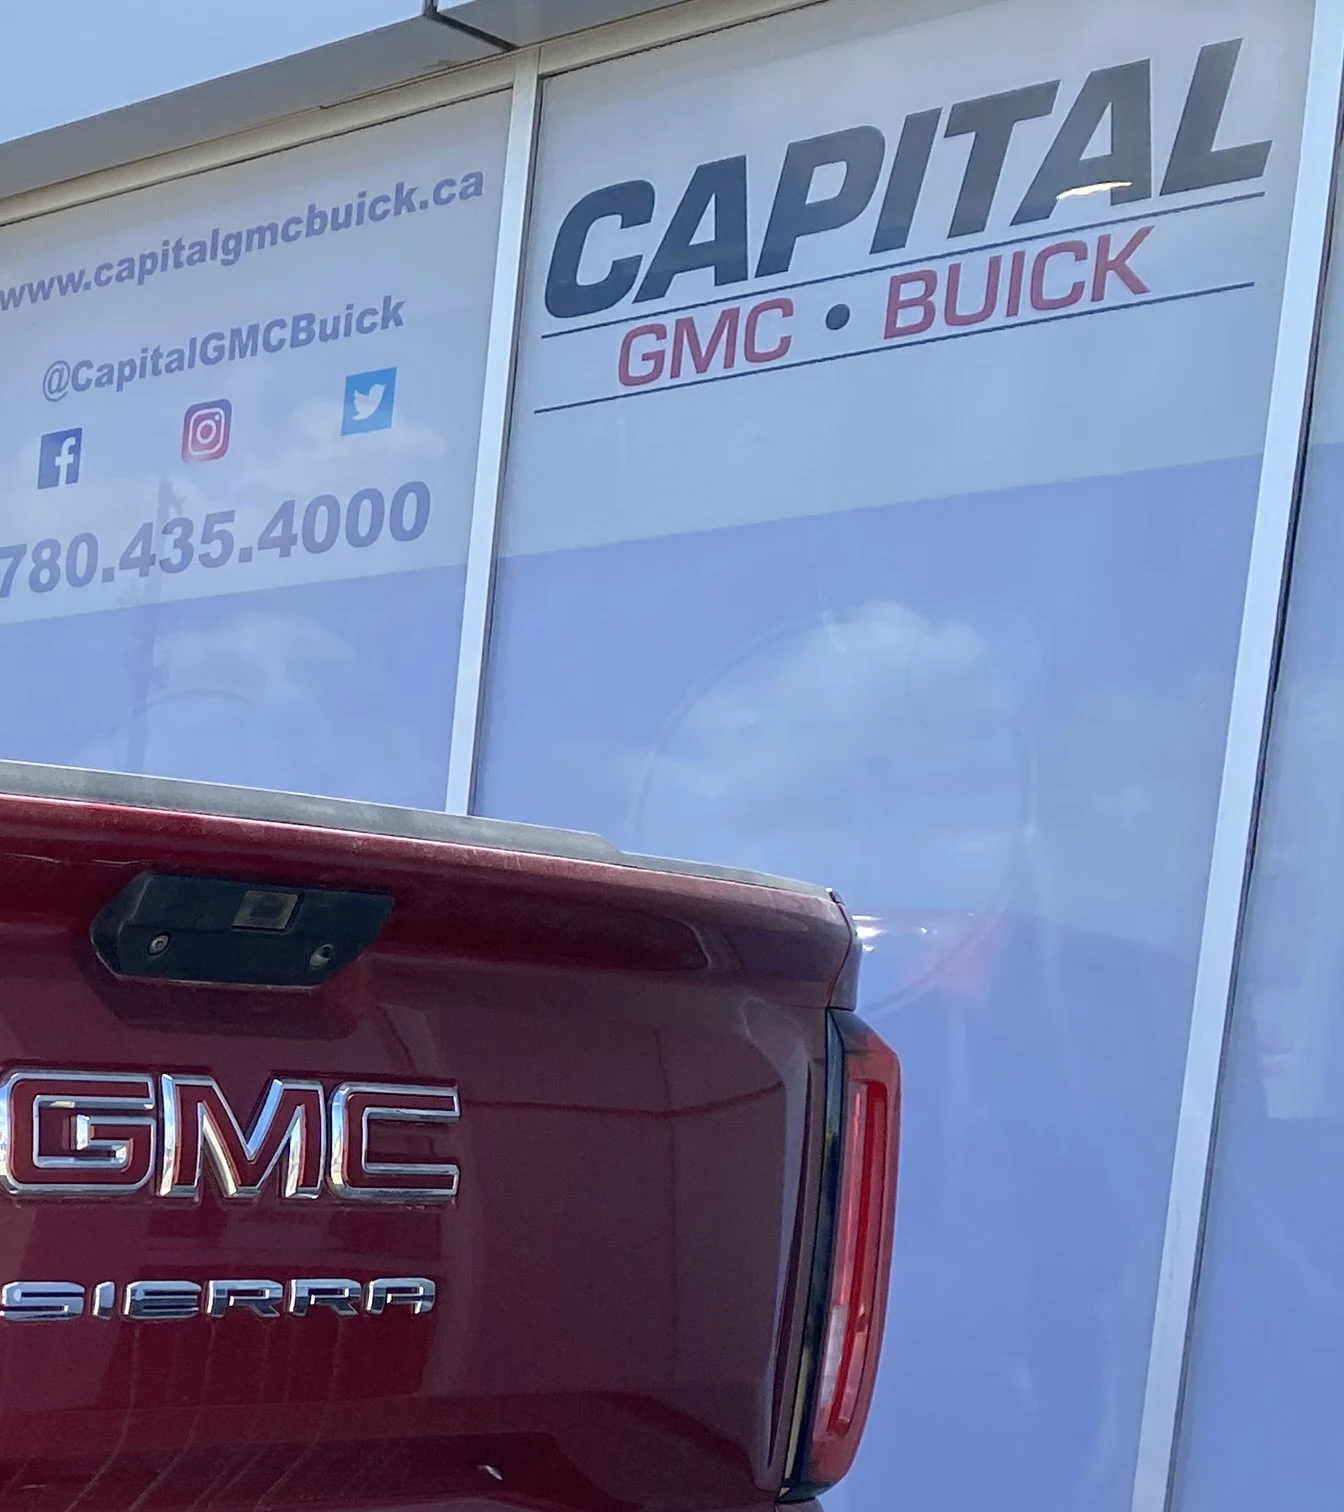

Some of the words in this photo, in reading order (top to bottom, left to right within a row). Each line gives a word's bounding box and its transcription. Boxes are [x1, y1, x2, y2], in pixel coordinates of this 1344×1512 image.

[543, 37, 1273, 320] CAPITAL
[42, 294, 406, 402] @CapitalGMCBuick
[617, 297, 794, 387] GMC
[883, 226, 1156, 341] BUICK
